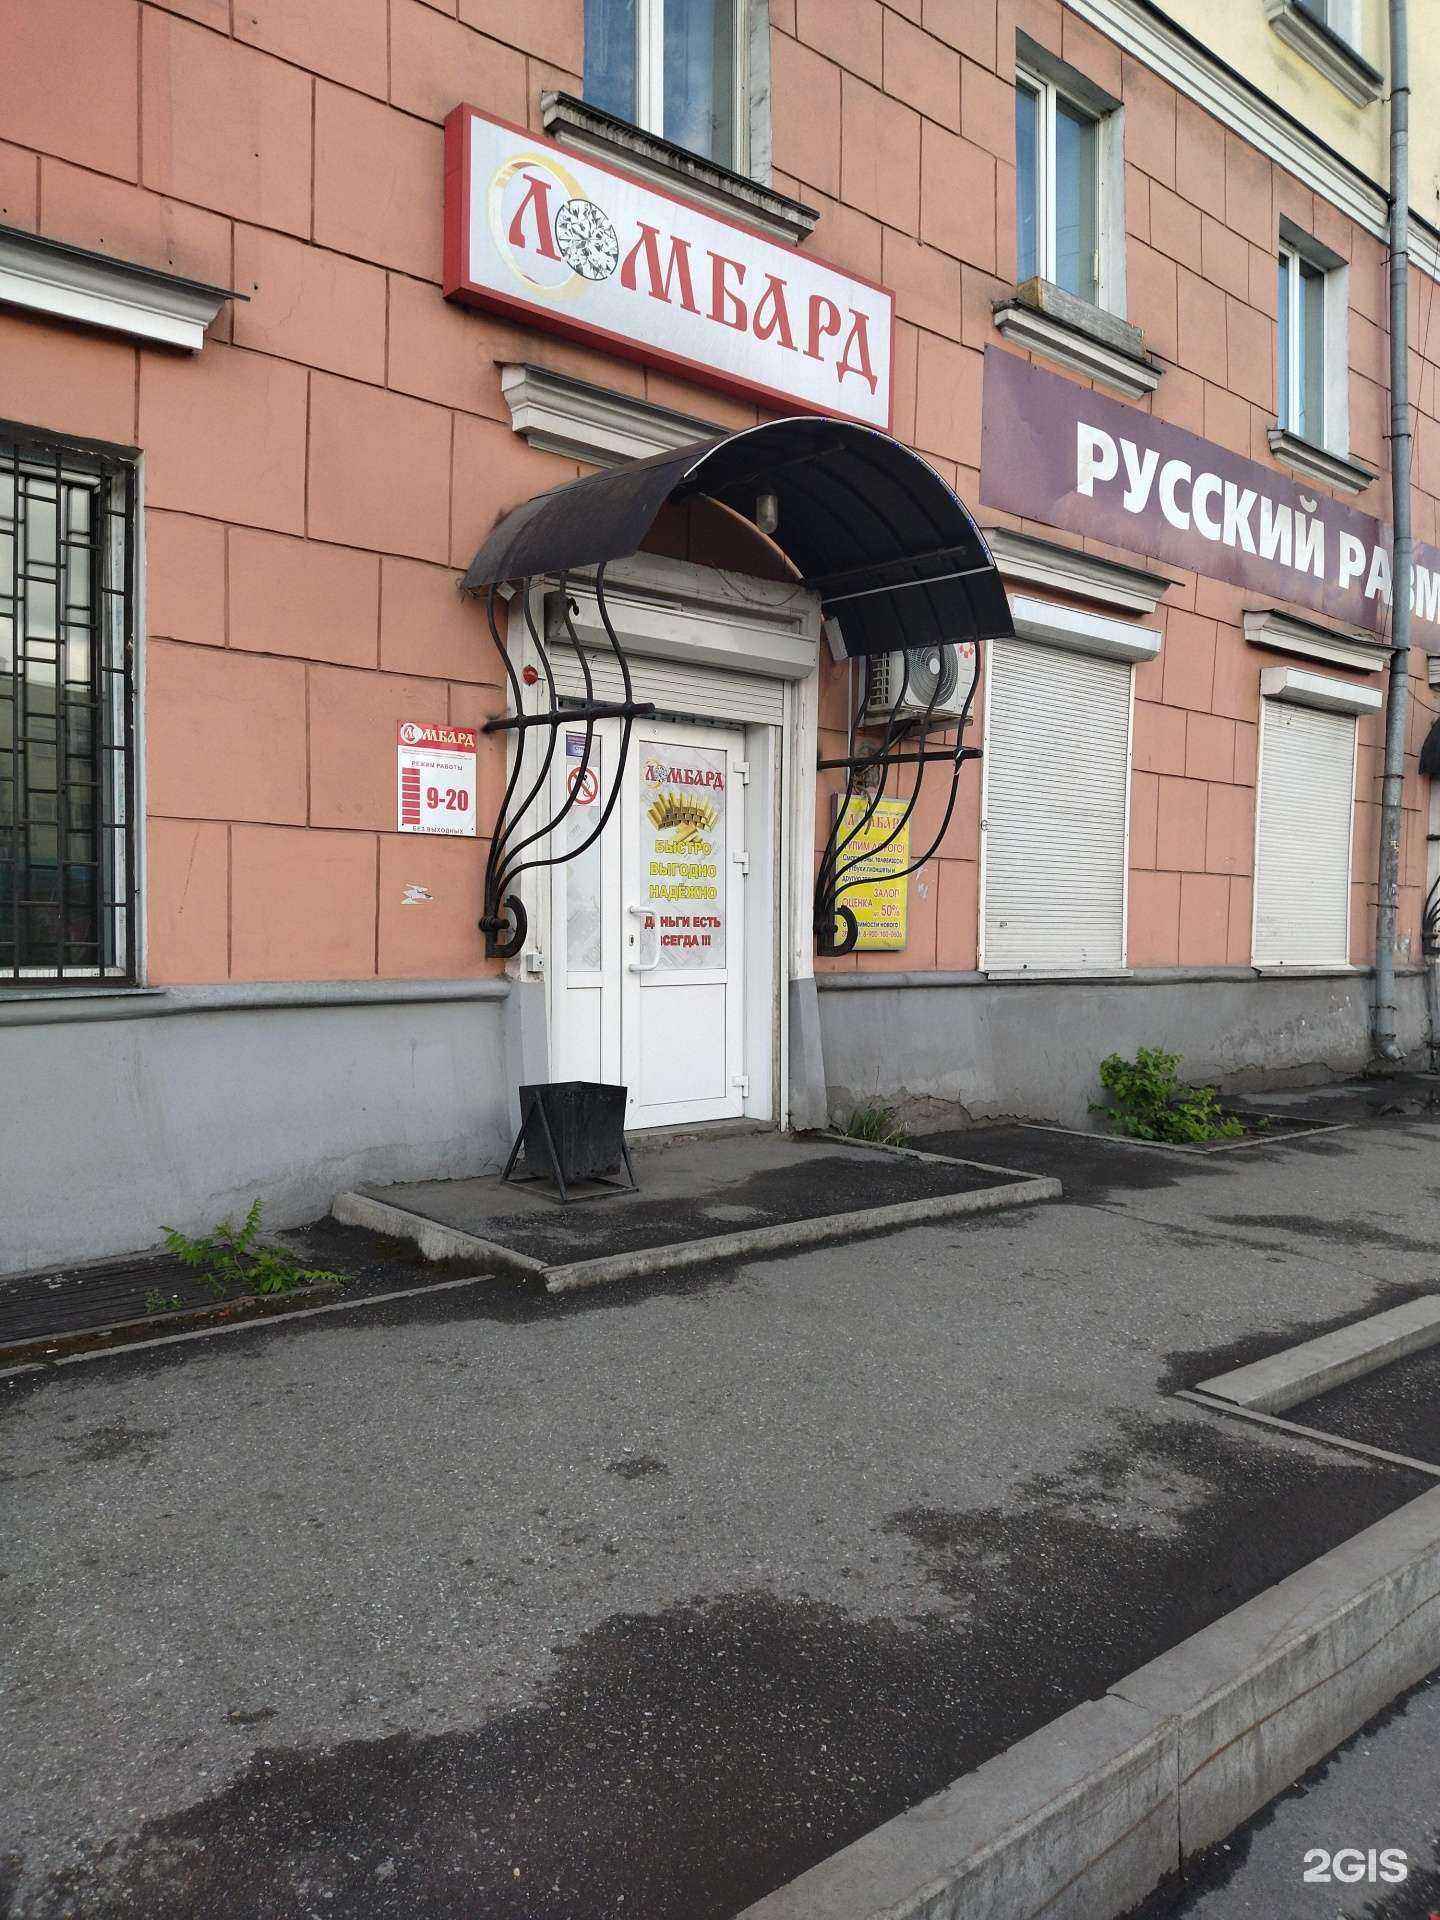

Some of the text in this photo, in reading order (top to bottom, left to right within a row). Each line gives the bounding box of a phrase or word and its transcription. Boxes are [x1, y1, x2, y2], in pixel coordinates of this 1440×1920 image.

[1077, 421, 1325, 579] РУССКИЙ
[436, 763, 463, 771] РАБОТЫ
[645, 765, 724, 791] ЛОМБАРД
[427, 787, 469, 811] 9-20
[426, 826, 464, 835] ВЫХОДНЫХ
[655, 839, 712, 856] БЫСТРО
[649, 862, 717, 879] ВЫГОДНО
[649, 883, 717, 901] НАДЁЖНО
[842, 897, 873, 908] ОЦЕНКА
[880, 904, 900, 917] 50%
[644, 916, 721, 930] ДНЬГИ ЕСТЬ
[660, 934, 699, 947] СЕГДА
